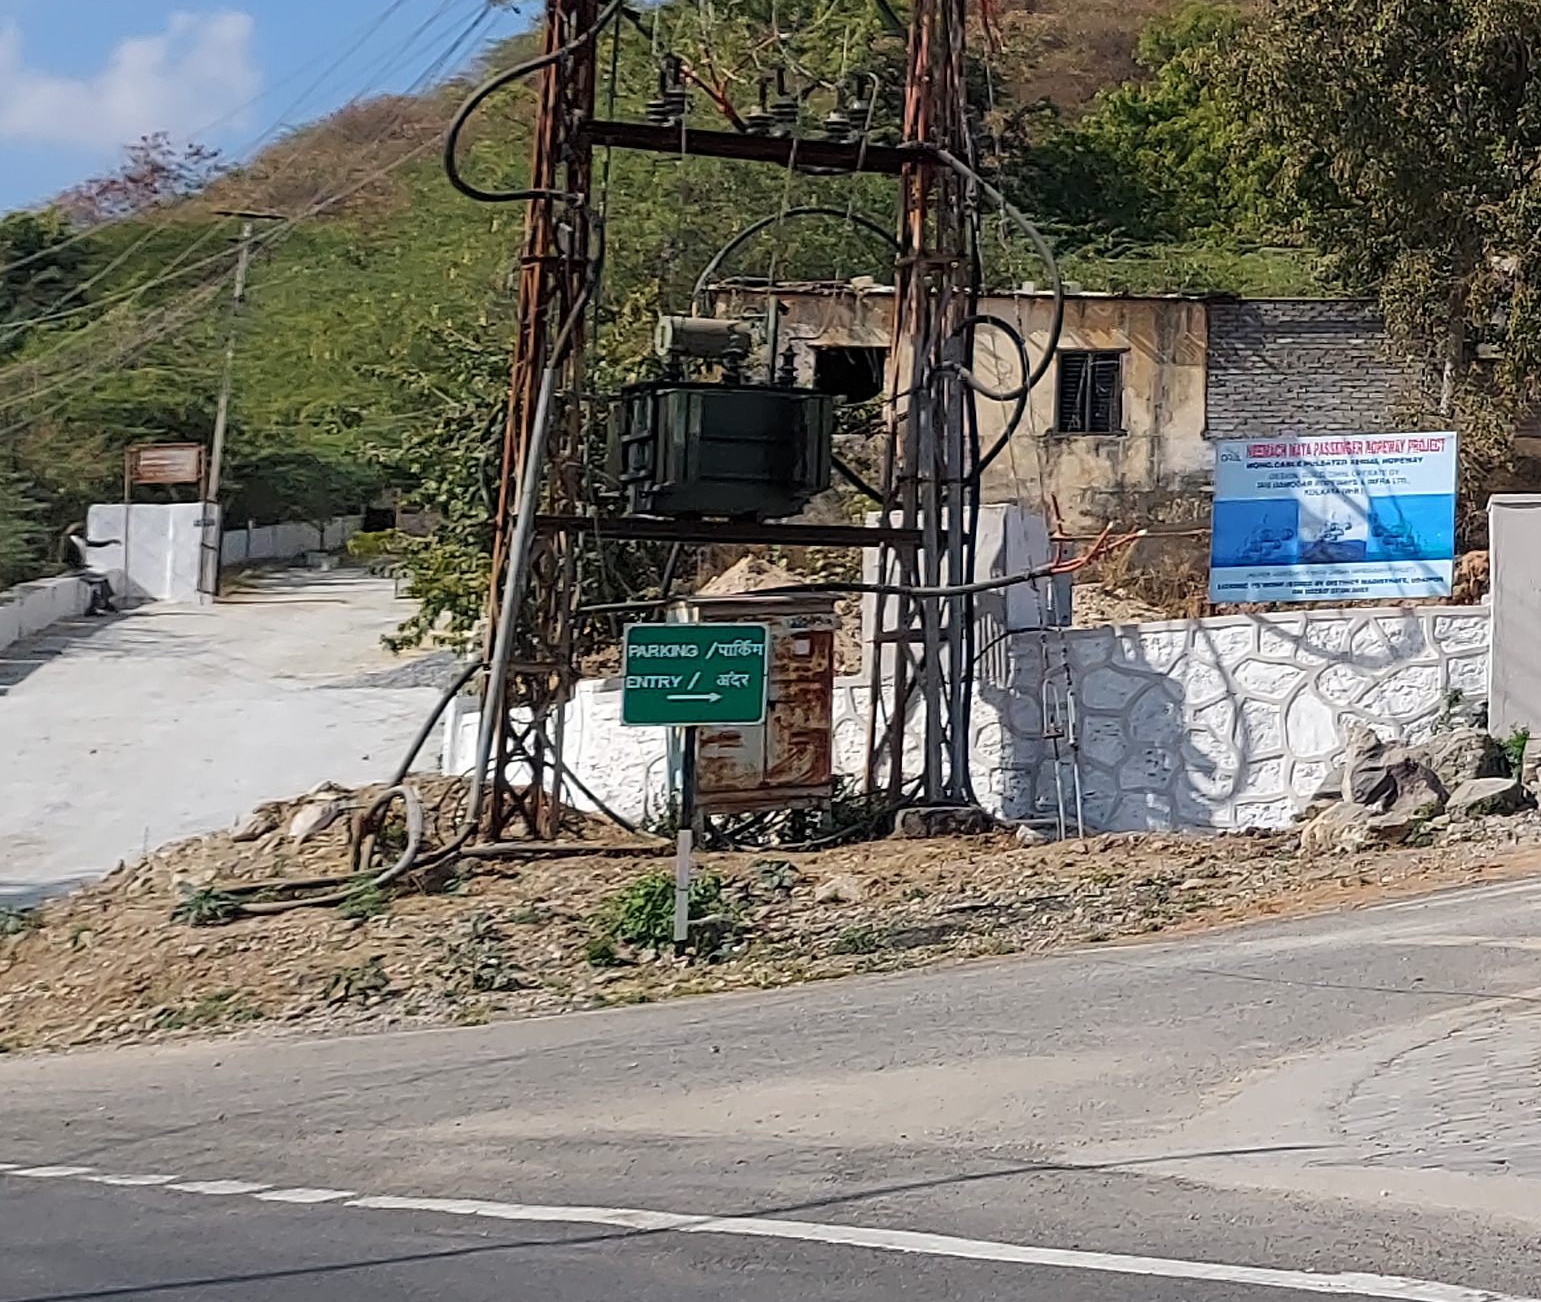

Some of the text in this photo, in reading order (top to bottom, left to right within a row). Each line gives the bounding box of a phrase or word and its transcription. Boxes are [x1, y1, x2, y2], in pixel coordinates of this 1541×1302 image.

[1314, 440, 1362, 456] PASSENGER
[1407, 437, 1445, 454] PROJECT
[628, 644, 699, 658] PARKING
[626, 675, 684, 689] ENTRY
